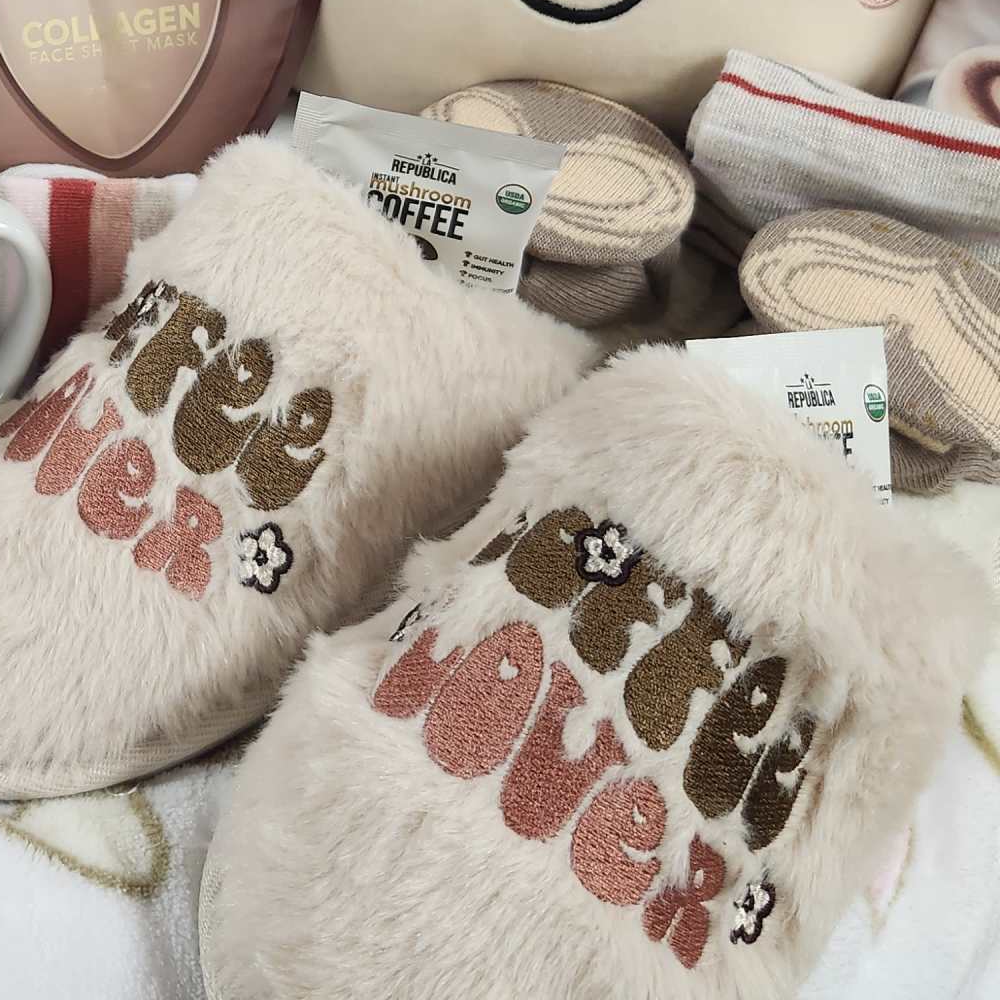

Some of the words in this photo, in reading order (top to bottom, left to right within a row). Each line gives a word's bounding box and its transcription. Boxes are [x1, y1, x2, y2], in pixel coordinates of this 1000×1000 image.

[29, 47, 75, 65] FACE
[80, 39, 140, 58] SHT
[148, 31, 199, 51] MASK
[421, 158, 431, 166] LA
[371, 172, 400, 183] INSTANT
[370, 179, 472, 209] mushroom
[505, 190, 525, 200] USDA
